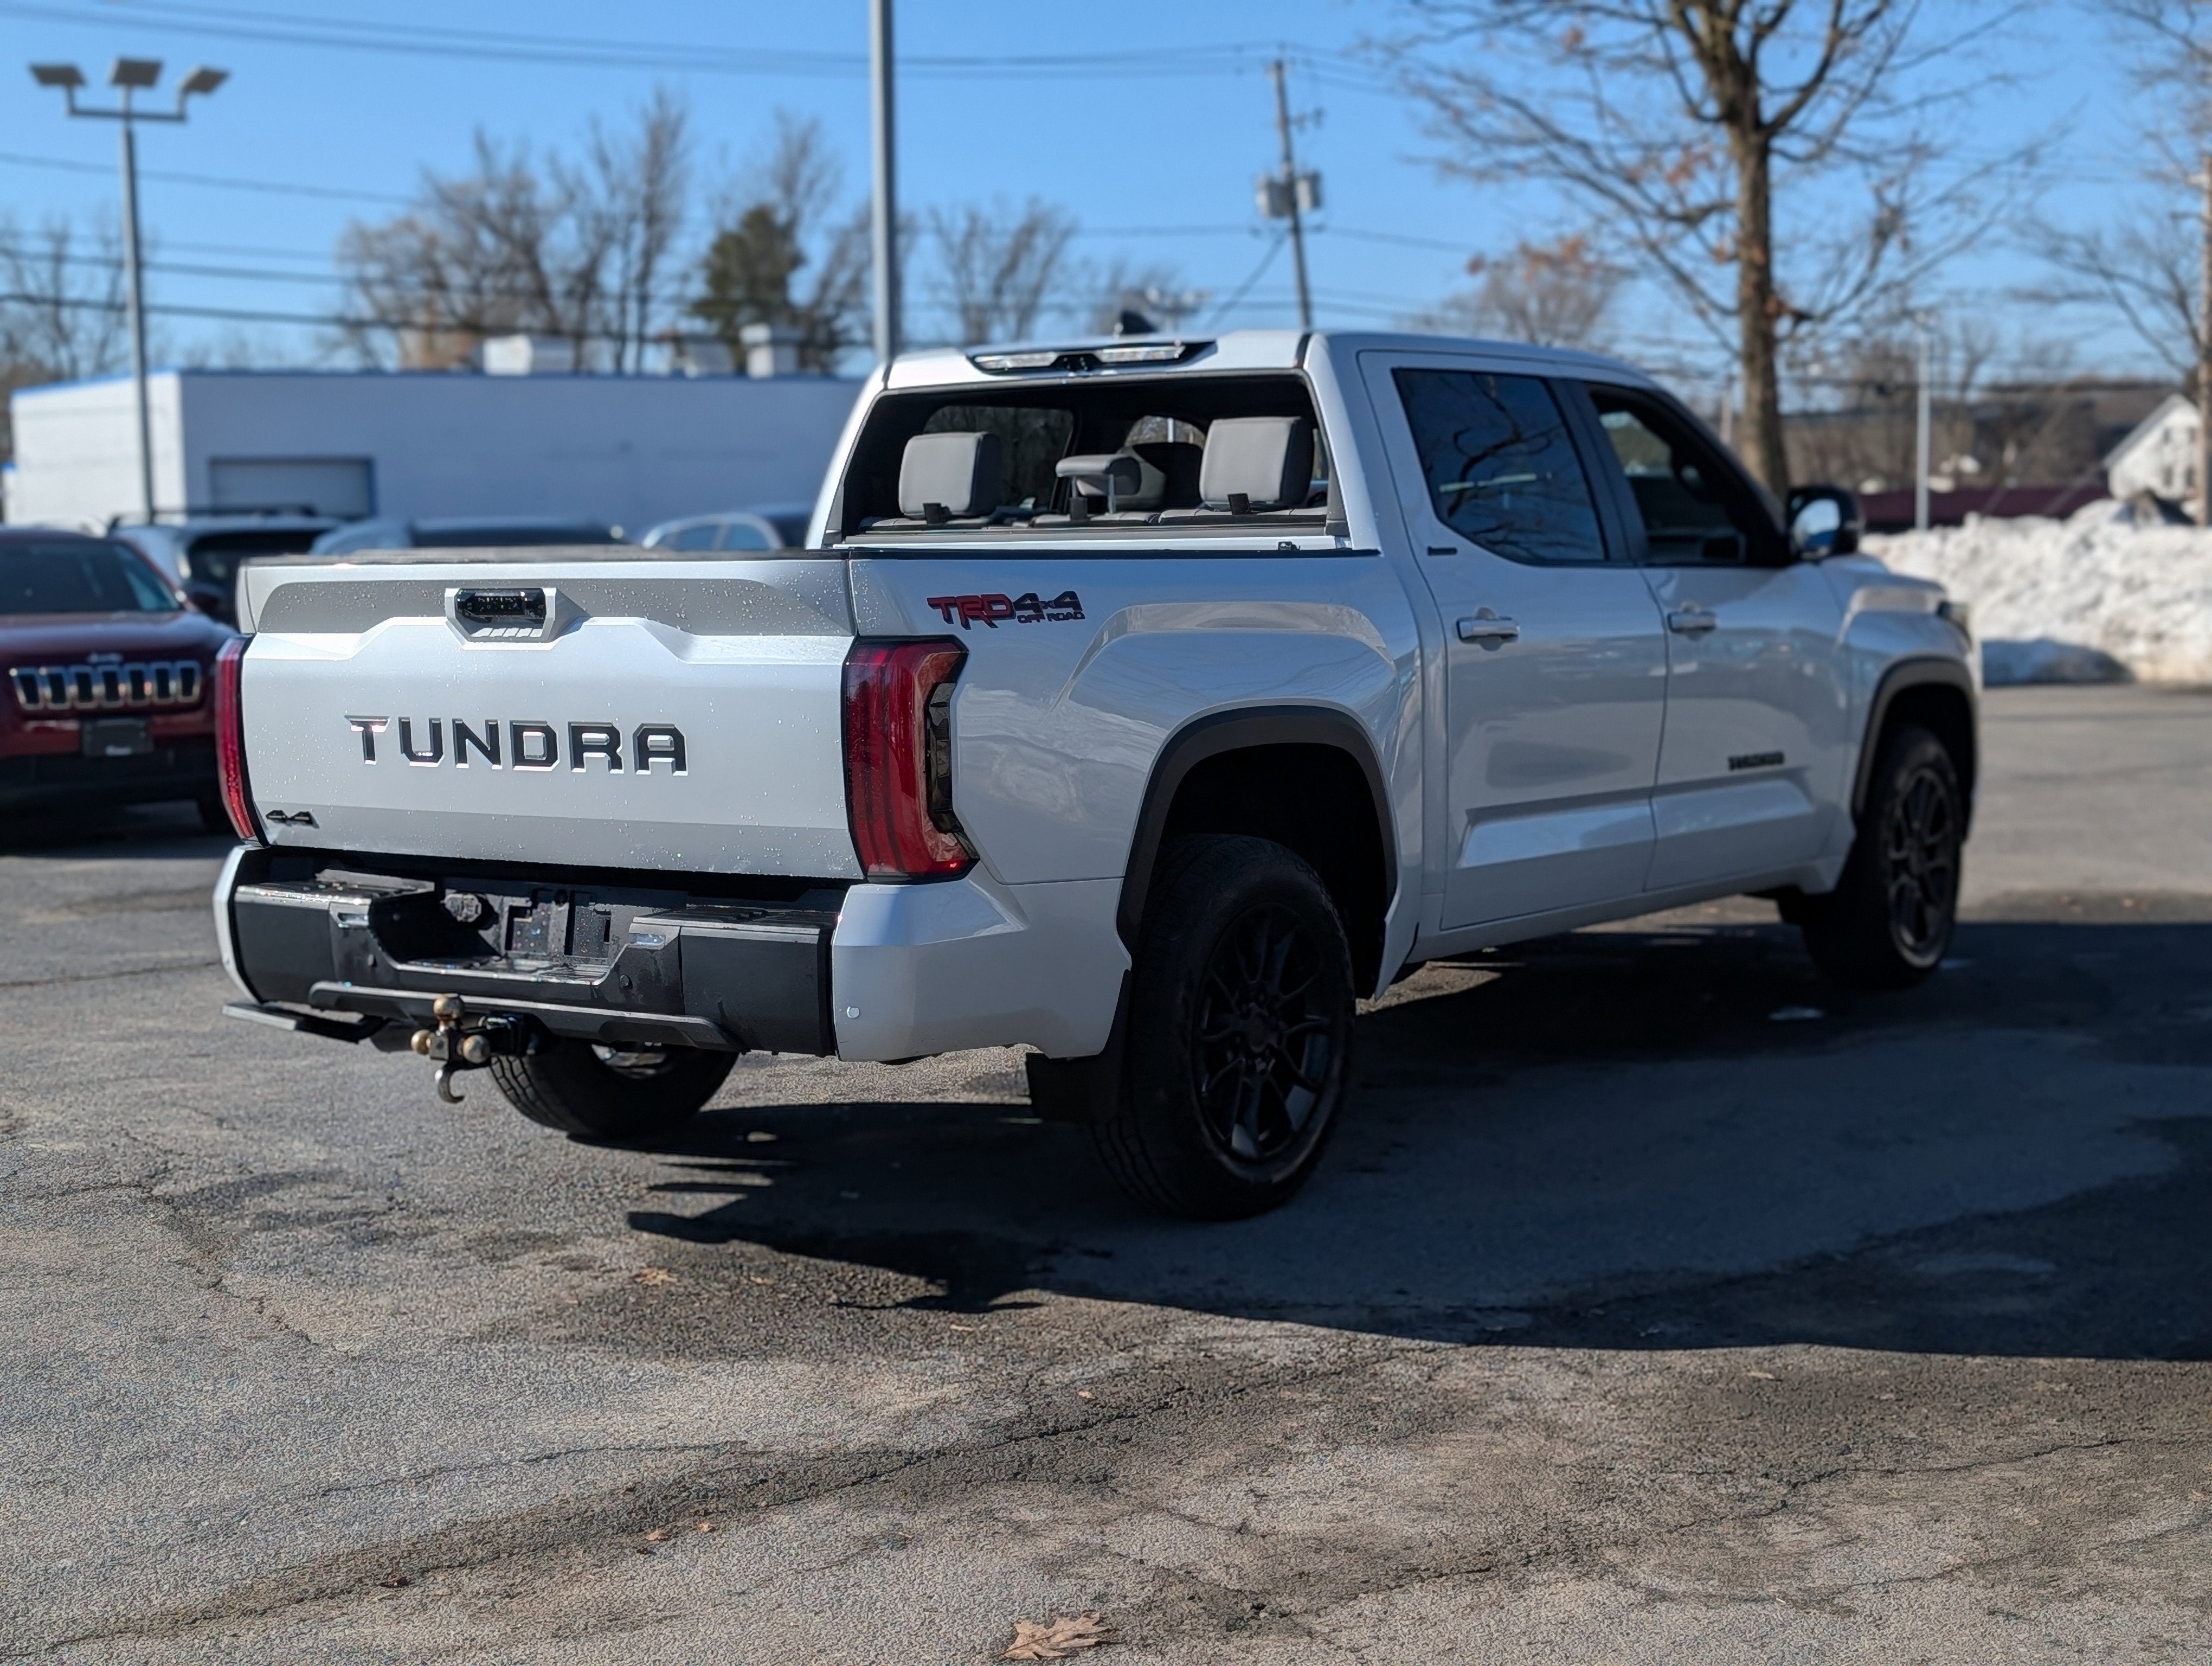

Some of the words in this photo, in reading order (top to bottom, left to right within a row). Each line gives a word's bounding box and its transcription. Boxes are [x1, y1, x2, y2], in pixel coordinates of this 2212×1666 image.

[927, 594, 1016, 630] TRD
[1017, 613, 1045, 624] OFF
[1046, 611, 1085, 622] ROAD
[344, 715, 689, 776] TUNDRA
